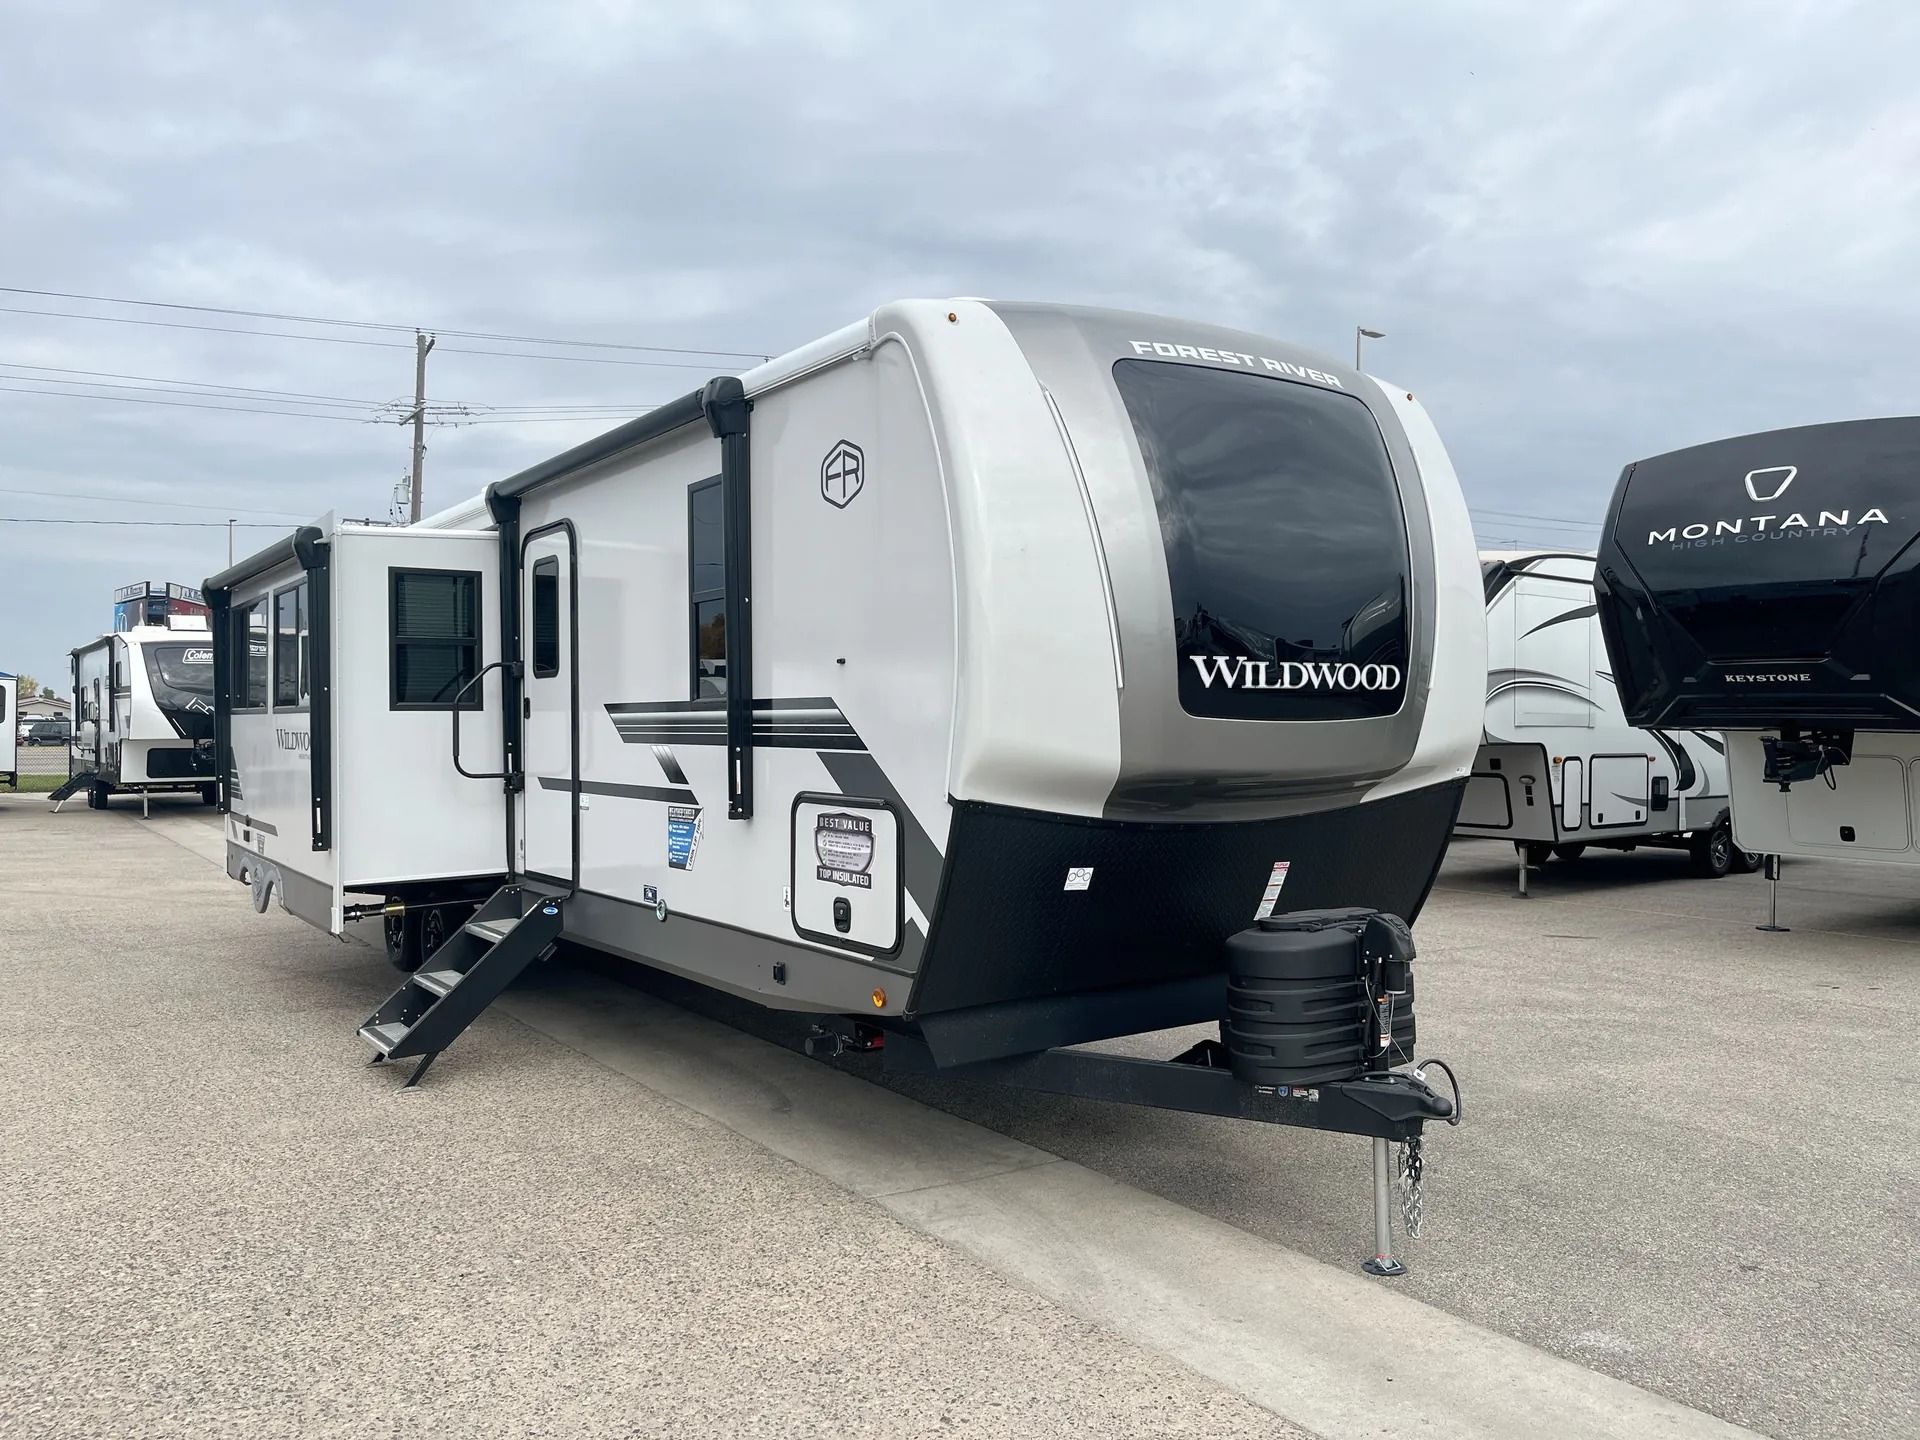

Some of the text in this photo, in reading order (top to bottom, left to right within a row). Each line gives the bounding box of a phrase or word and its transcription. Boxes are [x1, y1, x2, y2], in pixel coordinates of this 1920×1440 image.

[1129, 340, 1344, 389] FOREST RIVER
[1647, 508, 1890, 546] MONTANA
[1671, 526, 1857, 551] HIGH COUNTRY
[1189, 655, 1401, 691] WILDWOOD
[1724, 673, 1812, 683] KEYSTONE
[276, 728, 311, 752] WILDWO
[819, 817, 870, 832] BEST VALUE
[819, 868, 869, 886] TOP INSULATED
